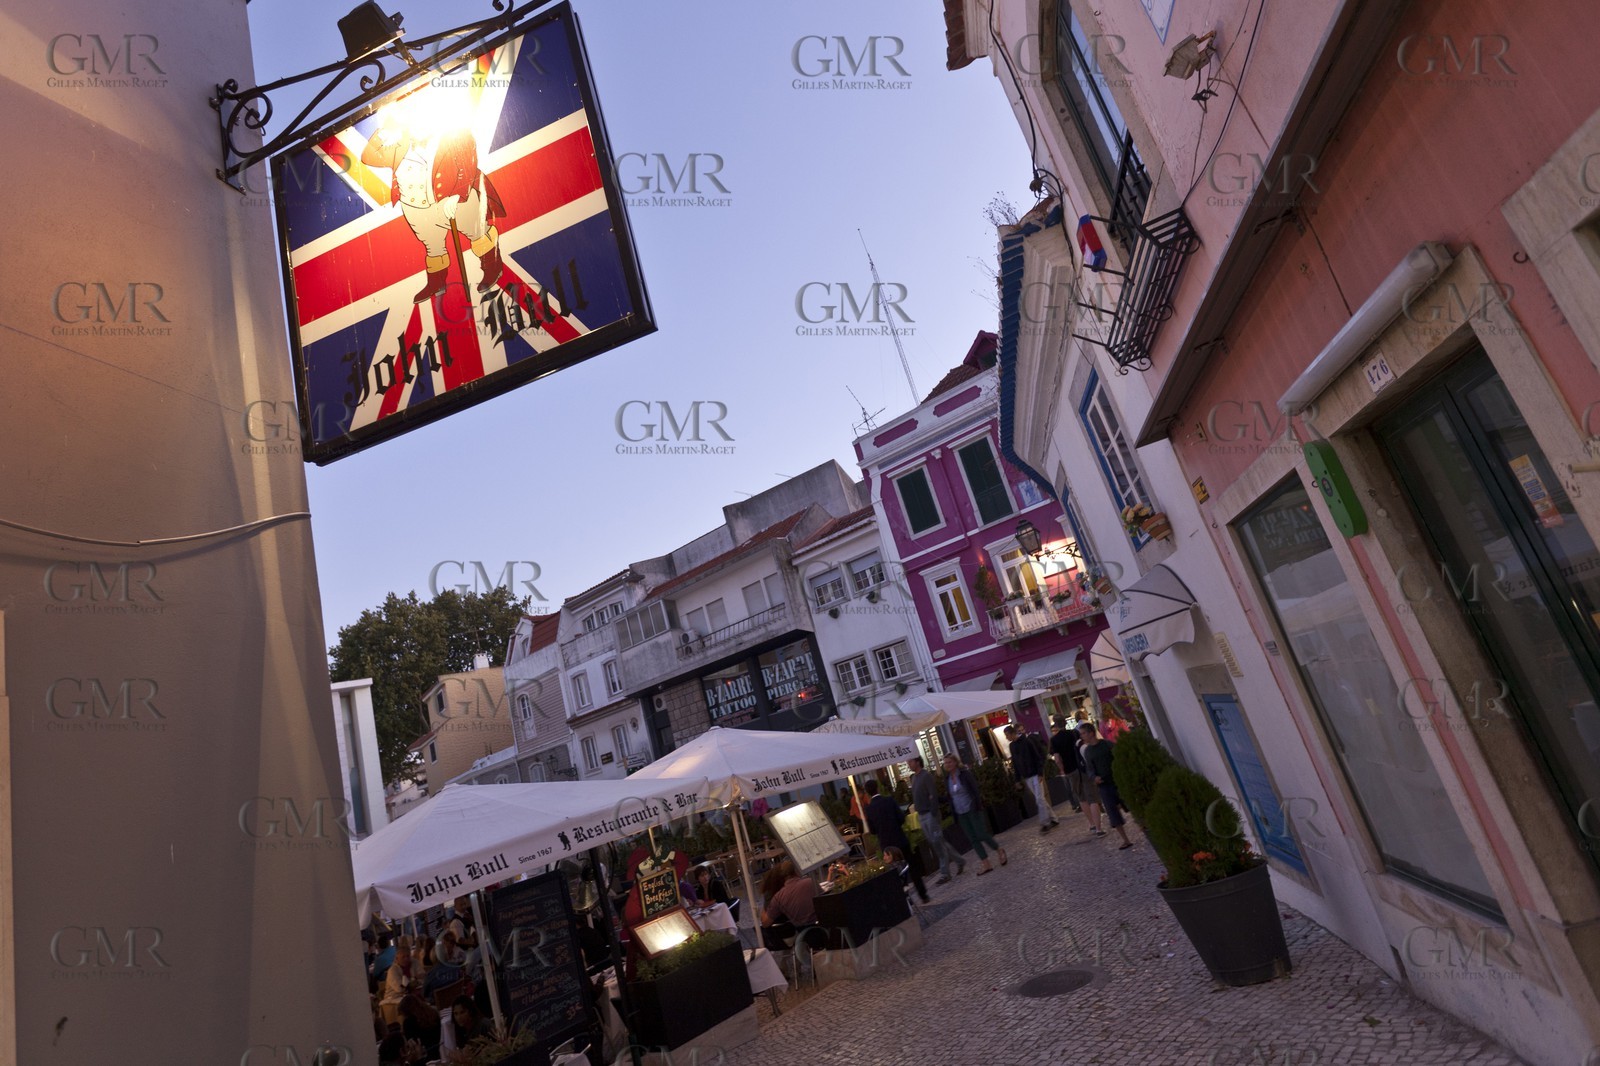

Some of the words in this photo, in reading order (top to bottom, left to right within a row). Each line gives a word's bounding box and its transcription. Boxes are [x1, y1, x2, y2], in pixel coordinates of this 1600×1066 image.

[341, 330, 453, 407] John
[480, 257, 589, 349] Bull
[710, 694, 757, 719] TATTOO
[752, 776, 780, 792] John
[781, 768, 806, 784] Bull
[839, 751, 888, 771] Restaurante
[888, 748, 896, 759] &
[895, 745, 912, 757] Bar
[406, 873, 463, 904] John
[465, 853, 509, 881] Bull
[518, 854, 536, 864] Since
[537, 846, 553, 858] 1967
[572, 804, 660, 844] Restaurante
[662, 798, 674, 812] &
[674, 792, 698, 809] Bar
[643, 875, 665, 893] English
[645, 888, 673, 905] Breakfast
